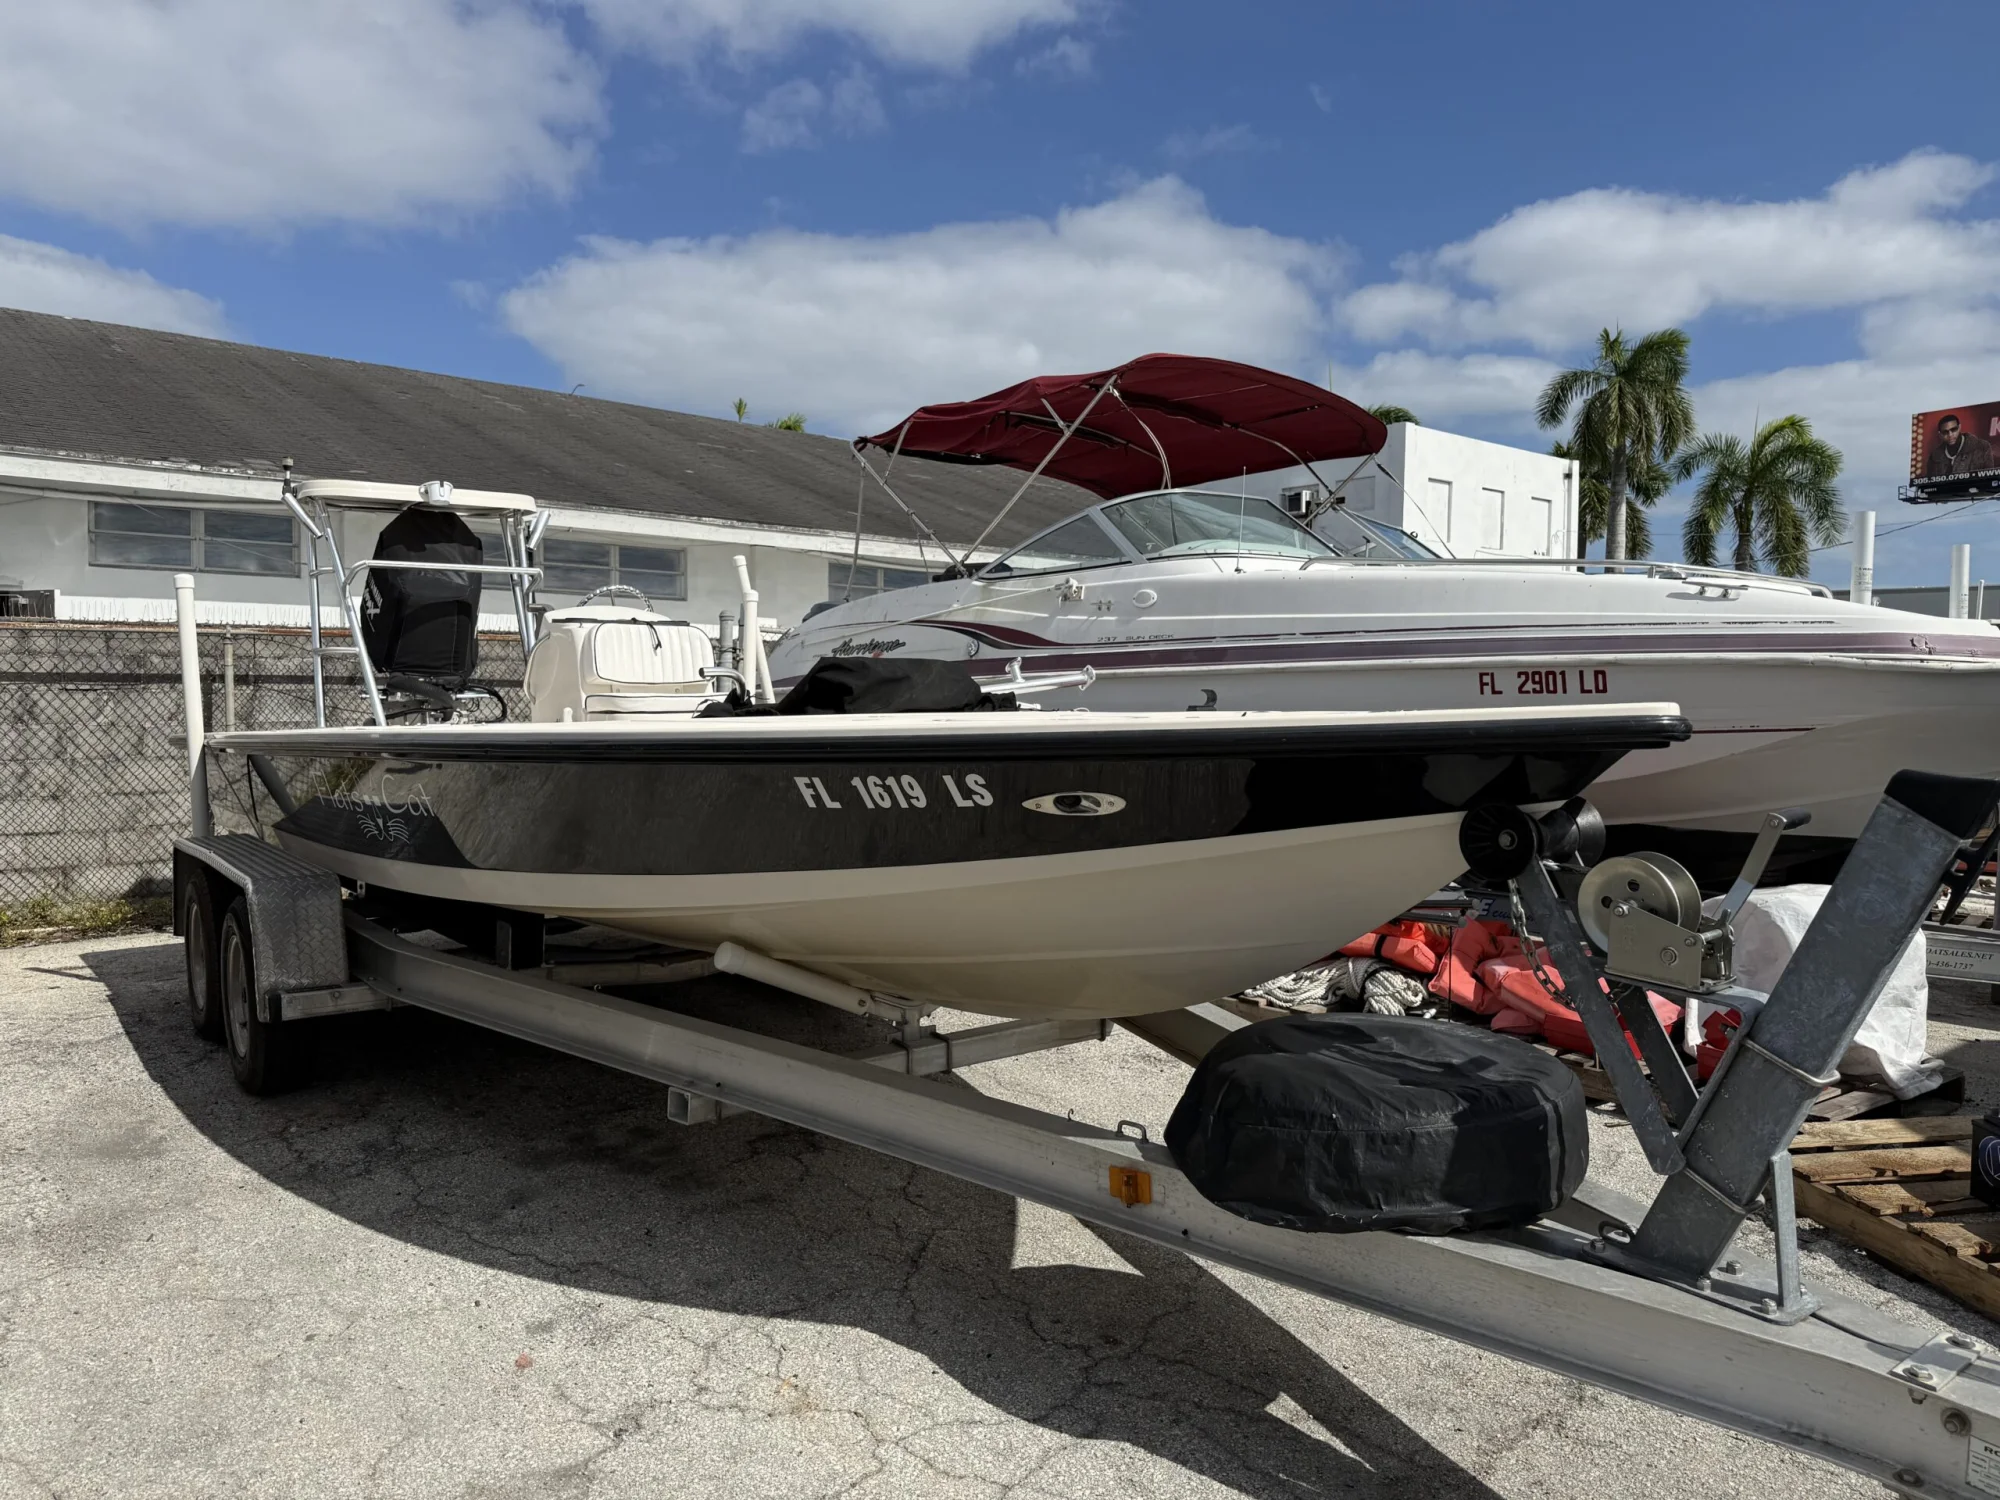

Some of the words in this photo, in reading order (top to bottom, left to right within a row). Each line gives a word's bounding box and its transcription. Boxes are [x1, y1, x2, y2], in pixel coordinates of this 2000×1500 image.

[1912, 472, 1970, 485] 305.350.0769
[831, 637, 906, 657] Hurricane
[1478, 672, 1503, 695] FL
[1517, 670, 1567, 695] 2901
[311, 769, 364, 812] Flats
[381, 773, 435, 817] Cat
[793, 776, 842, 809] FL
[851, 774, 927, 809] 1619
[941, 772, 994, 808] LS
[1926, 947, 1995, 961] OATSALES.NET
[1926, 959, 1974, 970] )-436-1737
